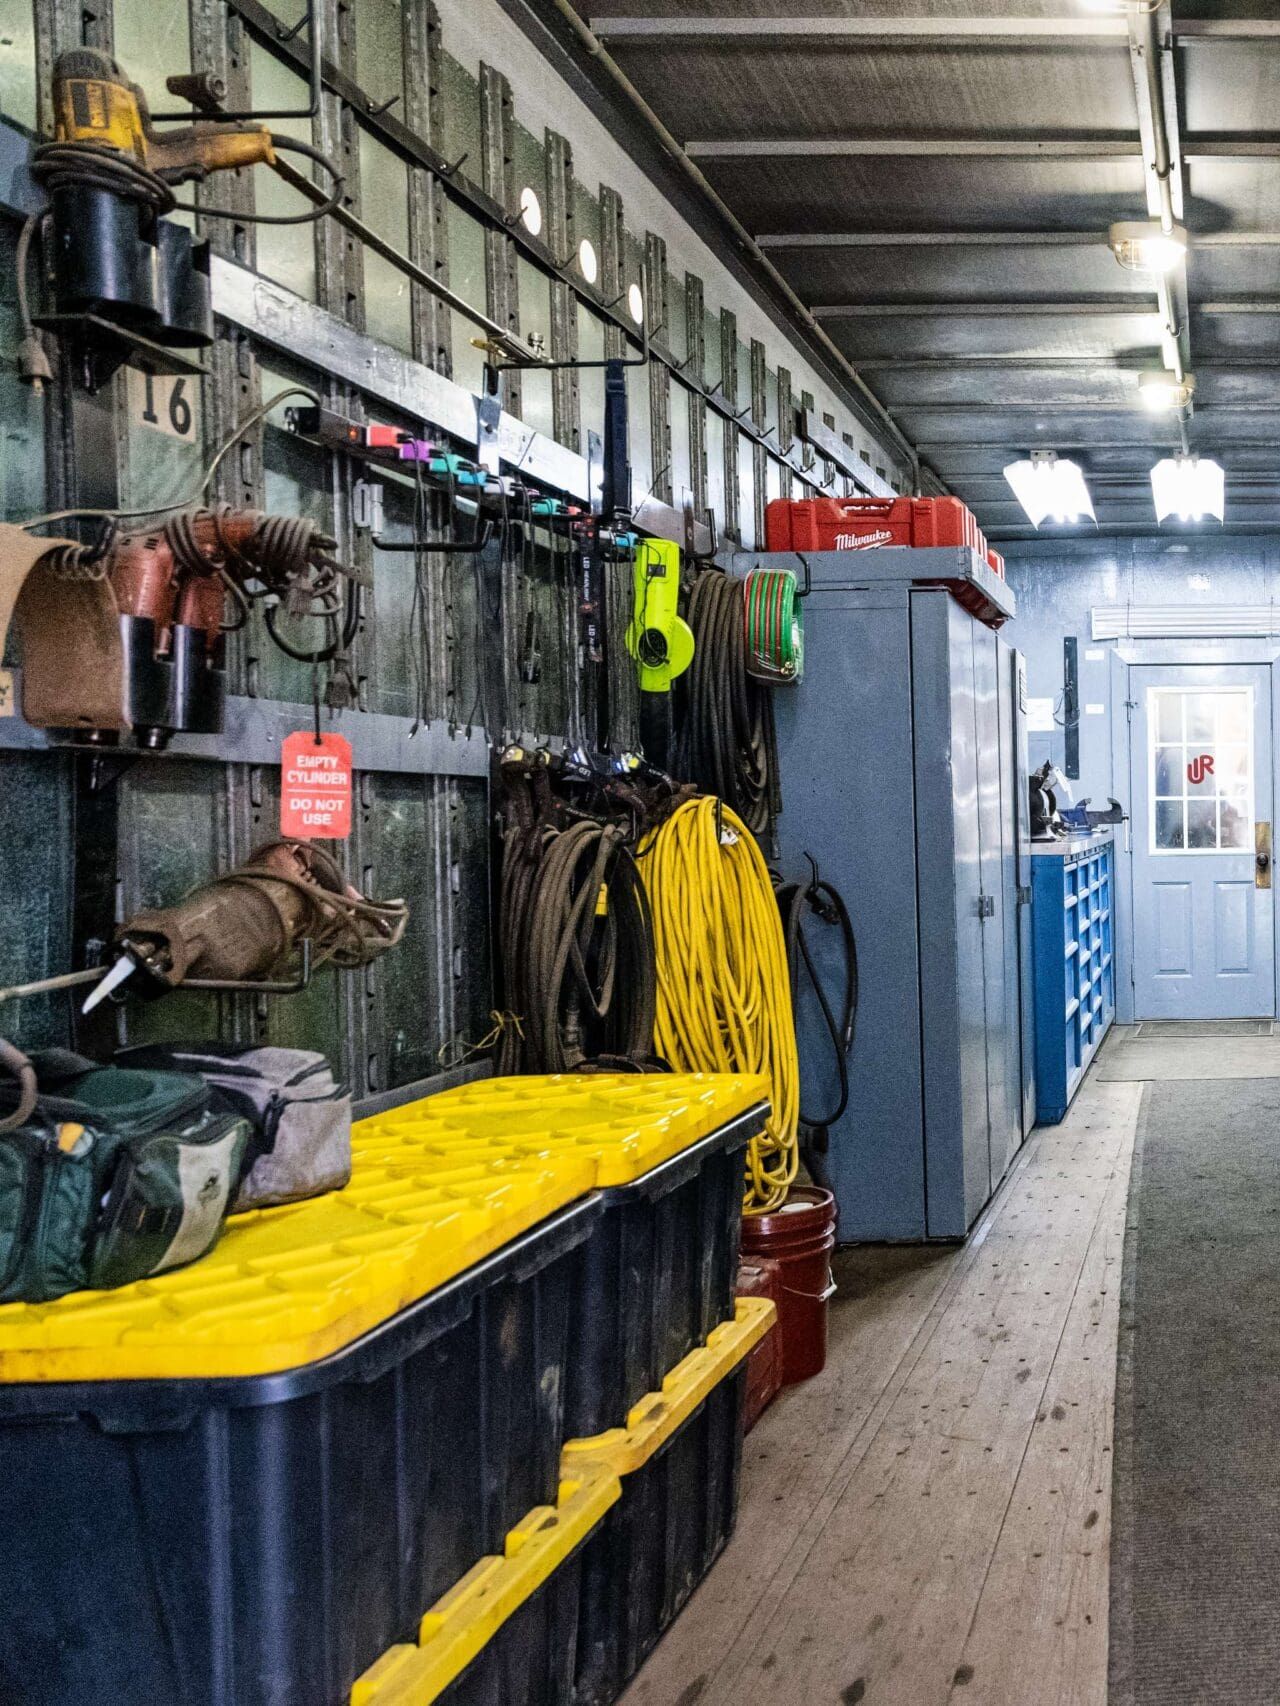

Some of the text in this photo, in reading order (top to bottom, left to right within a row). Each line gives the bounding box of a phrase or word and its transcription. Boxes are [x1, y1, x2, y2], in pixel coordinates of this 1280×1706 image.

[143, 373, 192, 436] 16
[833, 529, 893, 551] Milwaukee
[582, 556, 591, 569] LED
[588, 625, 596, 637] LED
[296, 755, 338, 769] EMPTY
[286, 769, 348, 785] CYLINDER
[289, 799, 345, 812] DO NOT
[302, 812, 332, 825] USE
